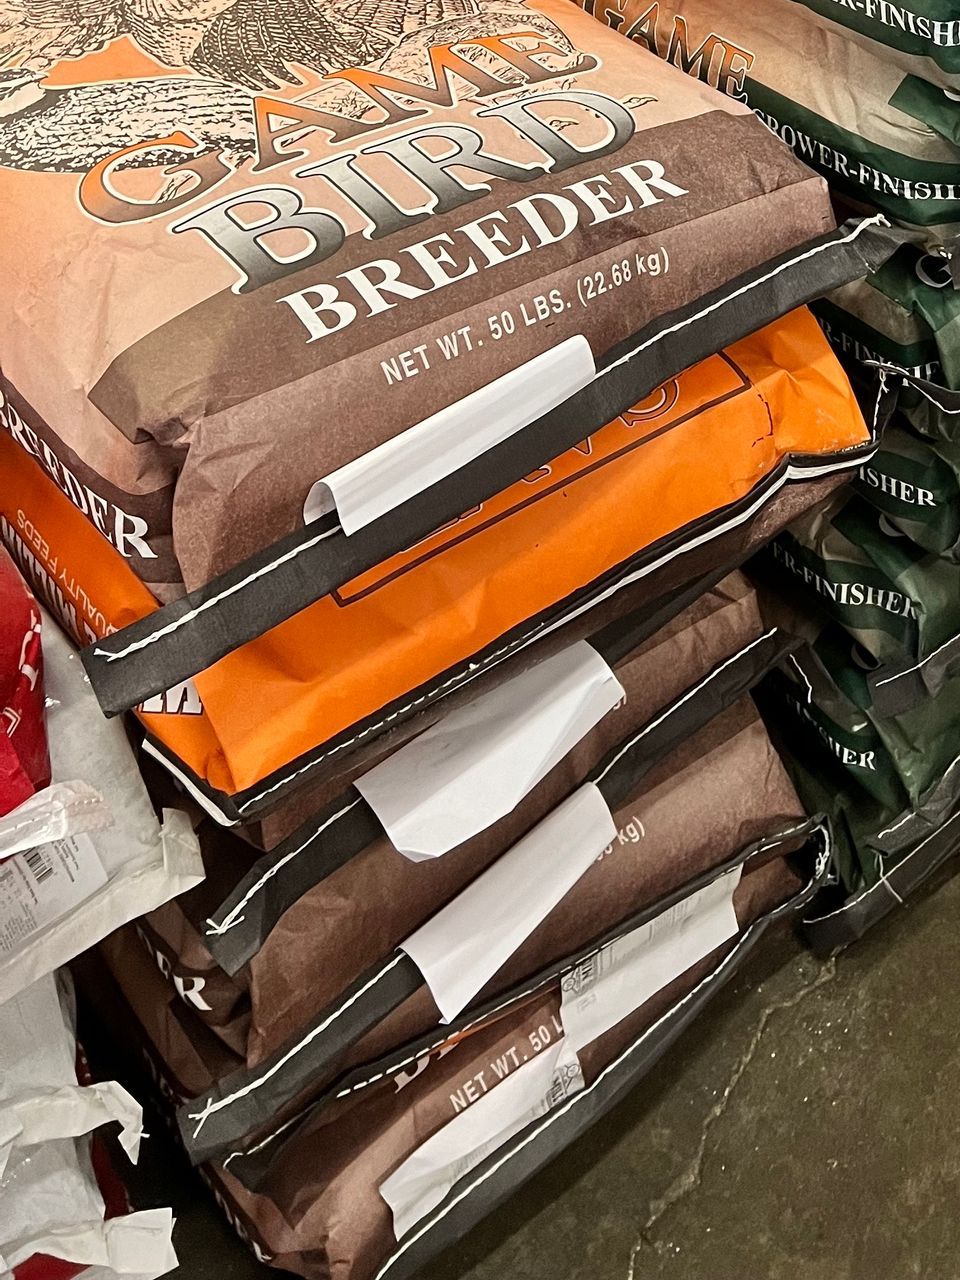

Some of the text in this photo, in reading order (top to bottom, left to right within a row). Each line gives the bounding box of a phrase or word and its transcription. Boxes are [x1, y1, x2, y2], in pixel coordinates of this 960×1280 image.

[77, 31, 600, 227] GAME
[173, 88, 636, 297] BIRD
[278, 159, 690, 345] BREEDER
[380, 245, 672, 386] NET WT. 50 LBS. (22.68 kg)
[16, 508, 59, 570] FEEDS
[617, 815, 646, 846] kg)
[450, 1072, 488, 1113] NET
[490, 1047, 528, 1080] WT.
[528, 1024, 551, 1051] 50
